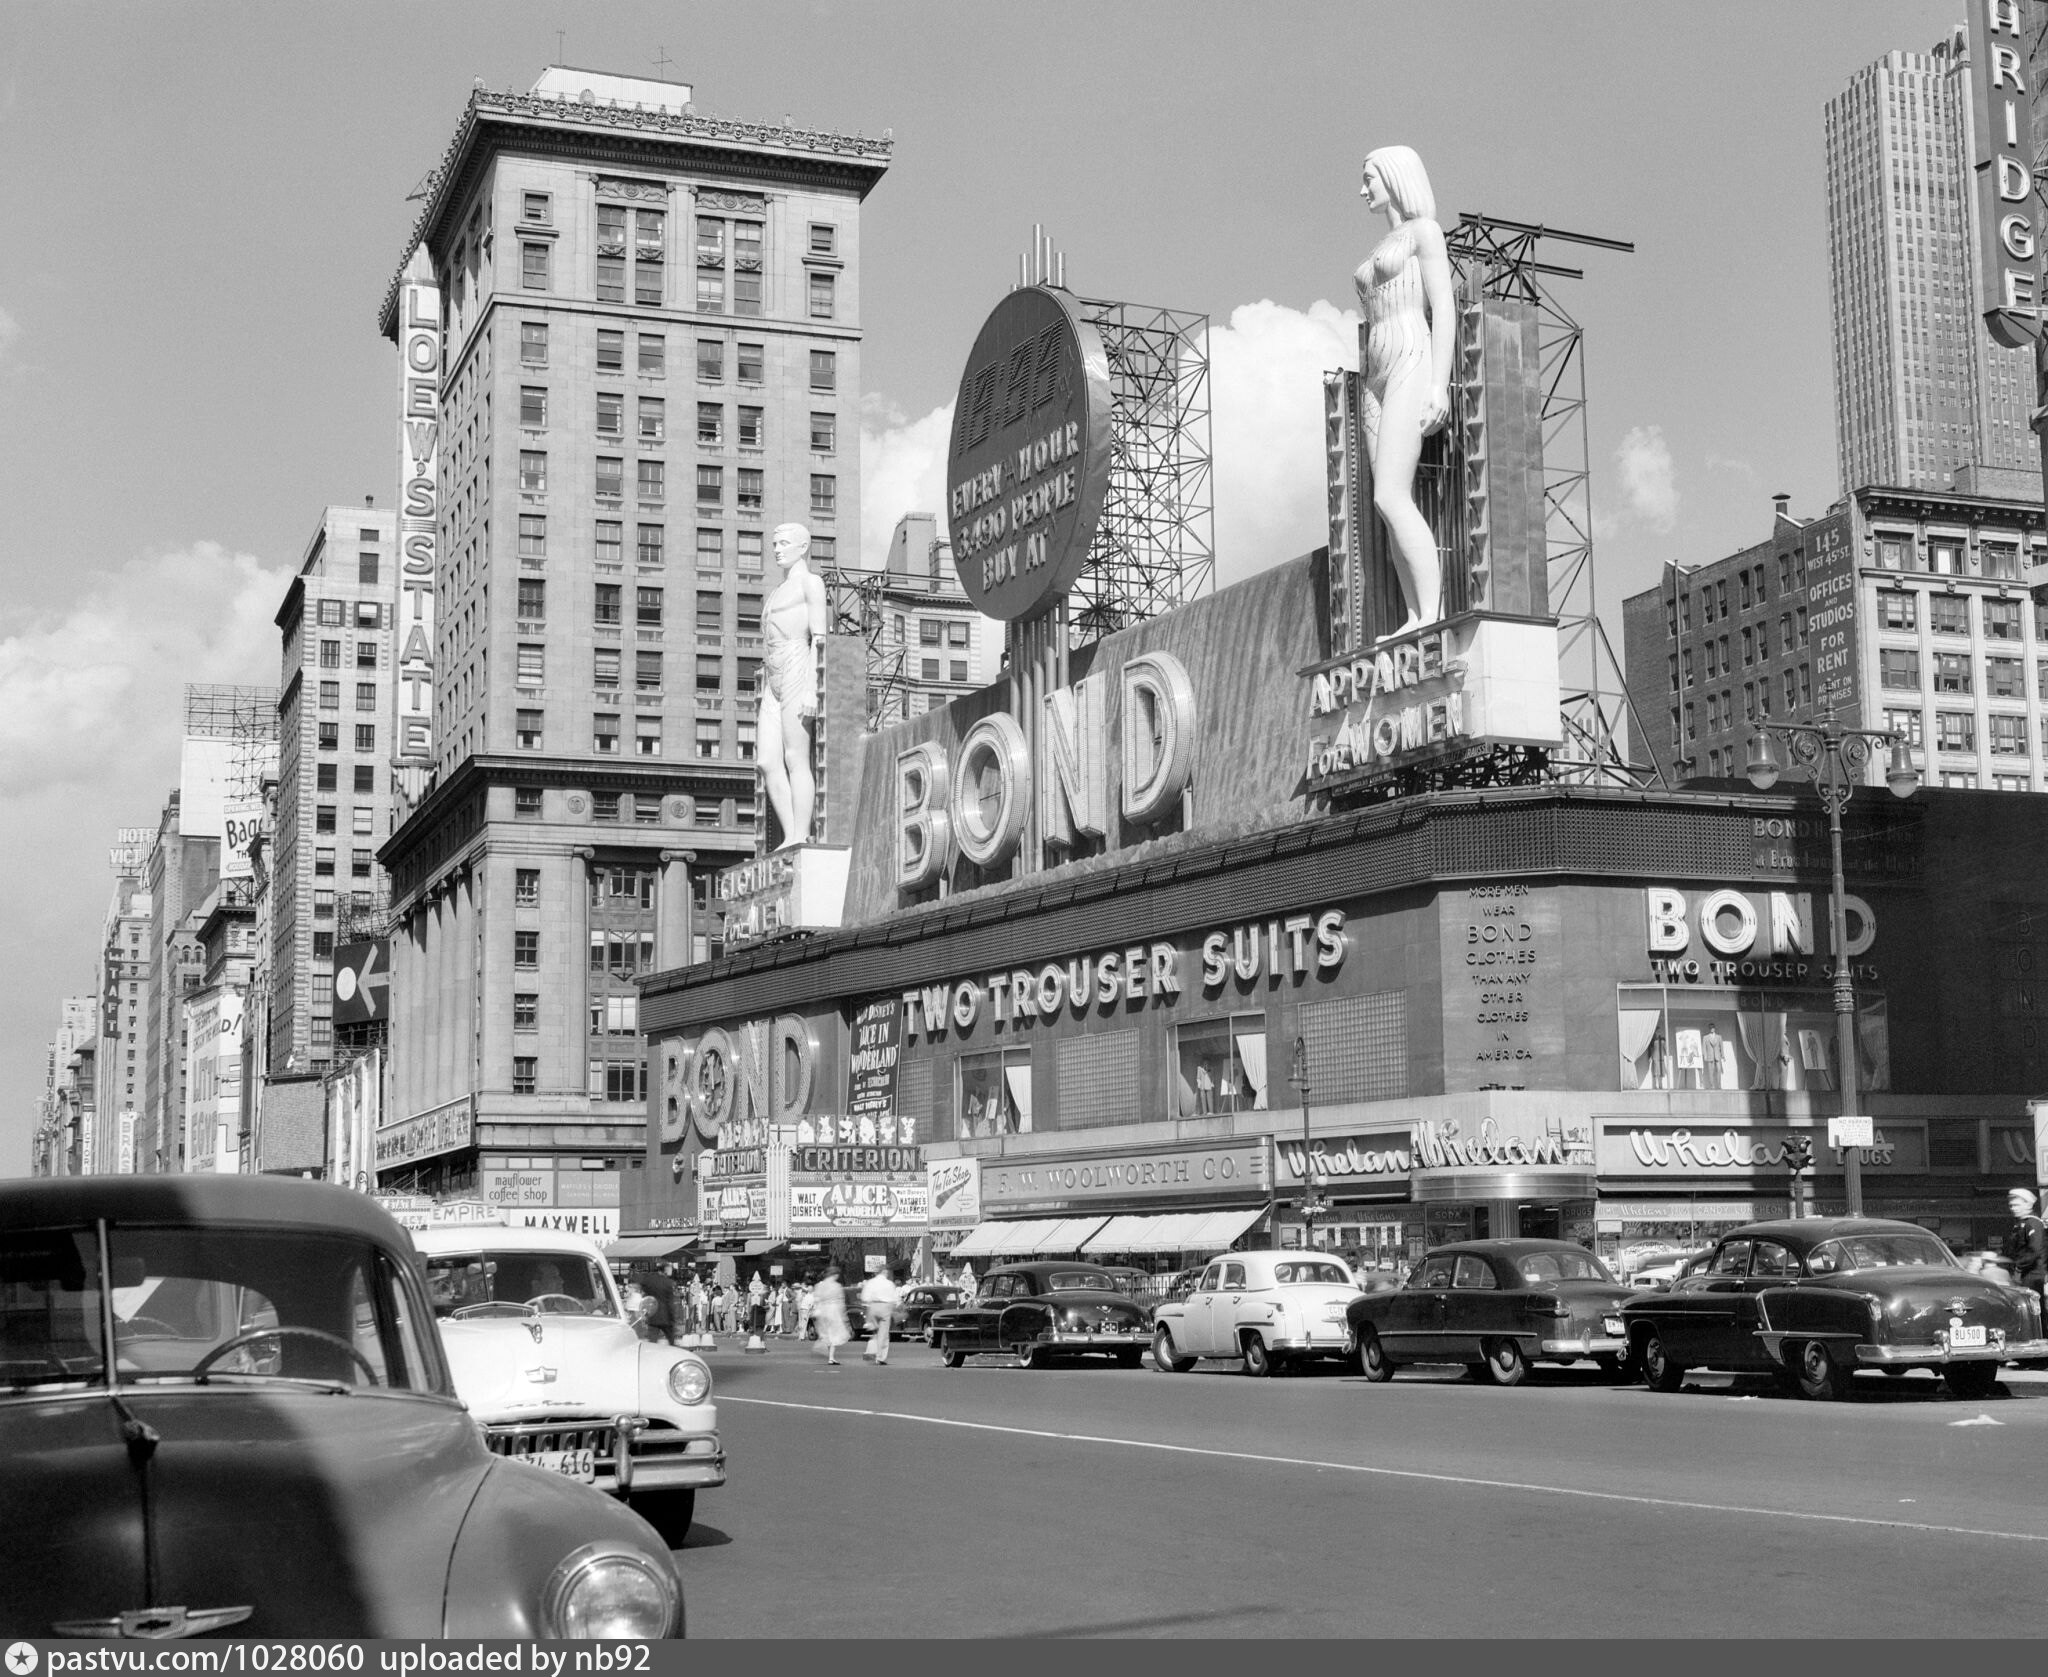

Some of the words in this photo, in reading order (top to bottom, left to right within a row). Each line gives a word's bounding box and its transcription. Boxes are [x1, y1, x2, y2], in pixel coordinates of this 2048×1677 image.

[403, 288, 438, 517] LOEW'S
[952, 461, 1002, 522] EVERY
[1018, 420, 1080, 485] HOUR
[1012, 466, 1076, 531] PEOPLE
[1815, 528, 1840, 552] 145
[982, 543, 1018, 592] BUY
[1025, 527, 1049, 572] AT
[1807, 555, 1824, 572] WEST
[1809, 573, 1852, 602] OFFICES
[1809, 602, 1854, 633] STUDIOS
[399, 533, 434, 757] STATE
[1820, 631, 1845, 651] FOR
[1817, 648, 1848, 673] RENT
[1309, 628, 1468, 718] APPAREL
[1843, 675, 1852, 686] ON
[1817, 687, 1852, 706] PRMISES
[1348, 692, 1464, 767] WOMEN
[895, 649, 1196, 890] BOND
[1468, 886, 1501, 898] MORE
[1503, 884, 1529, 896] MEN
[1481, 904, 1516, 917] WEAR
[1646, 887, 1877, 957] BOND
[1467, 923, 1534, 944] BOND
[1202, 908, 1349, 988] SUITS
[1465, 948, 1537, 965] CLOTHES
[1472, 973, 1504, 986] THAN
[1504, 971, 1531, 986] ANY
[1655, 958, 1700, 982] TWO
[1713, 961, 1808, 980] TROUSER
[901, 976, 983, 1035] TWO
[988, 940, 1182, 1022] TROUSER
[1481, 991, 1523, 1004] OTHER
[1477, 1010, 1529, 1024] CLOTHES
[878, 1021, 890, 1045] IN
[1497, 1032, 1510, 1043] IN
[1475, 1049, 1533, 1062] AMERICA
[660, 1013, 816, 1144] BOND
[804, 1148, 917, 1172] CRITERION
[1288, 1138, 1411, 1178] Whelan
[495, 1173, 543, 1187] mayflower
[1048, 1159, 1190, 1190] WOOLWORTH
[1203, 1155, 1242, 1181] CO.
[489, 1186, 518, 1202] coffee
[524, 1188, 548, 1201] shop
[798, 1193, 817, 1205] WALT
[831, 1184, 889, 1206] ALICE
[433, 1205, 496, 1221] EMPIRE
[792, 1203, 823, 1217] DISNEY'S
[1565, 1207, 1592, 1217] DRUGS
[1695, 1206, 1729, 1217] CANDY
[1734, 1205, 1784, 1216] LUNCHEON
[525, 1215, 610, 1234] MAXWELL
